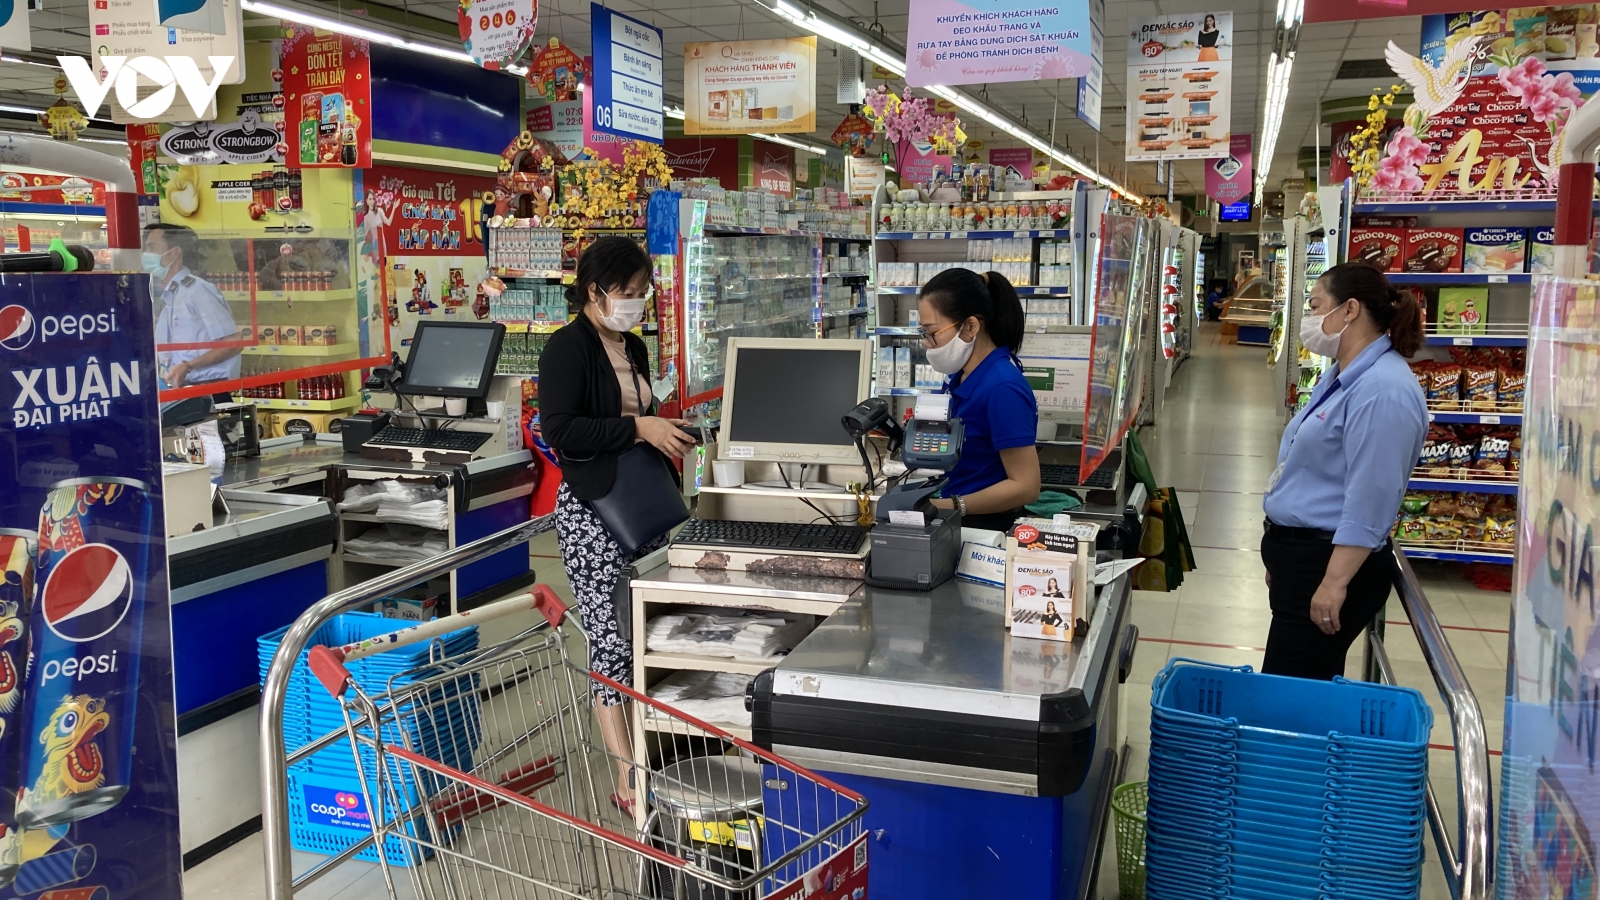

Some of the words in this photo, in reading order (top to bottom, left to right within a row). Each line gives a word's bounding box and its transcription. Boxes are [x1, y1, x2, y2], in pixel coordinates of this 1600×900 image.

[482, 18, 488, 29] 2
[494, 15, 500, 26] 4
[508, 13, 514, 23] 6
[936, 11, 972, 24] KHUYẾN
[972, 10, 1000, 22] KHÍCH
[1001, 9, 1032, 20] KHÁCH
[1033, 6, 1059, 17] HÀNG
[112, 21, 125, 29] Phiếu
[138, 21, 151, 29] hàng
[953, 25, 972, 35] ĐEO
[972, 22, 997, 34] KHẨU
[998, 23, 1029, 33] TRANG
[1028, 19, 1041, 30] VÀ
[1141, 24, 1161, 33] ĐEN
[193, 35, 215, 43] paywave
[624, 25, 633, 37] Bột
[633, 29, 642, 40] ngũ
[641, 29, 650, 42] cốc
[917, 38, 936, 50] RỬA
[937, 39, 952, 50] TAY
[954, 35, 978, 49] BẰNG
[979, 35, 1005, 47] DUNG
[1005, 35, 1027, 46] DỊCH
[1028, 31, 1047, 43] SÁT
[1047, 29, 1079, 43] KHUẨN
[114, 48, 123, 56] Quy
[935, 50, 948, 61] ĐỂ
[948, 49, 979, 61] PHÒNG
[981, 46, 1010, 60] TRÁNH
[1011, 47, 1033, 58] DỊCH
[1033, 43, 1059, 57] BỆNH
[1144, 45, 1163, 57] 80%
[308, 53, 326, 70] ĐÓN
[328, 50, 343, 68] TẾT
[623, 53, 634, 64] Bánh
[634, 57, 641, 66] ăn
[641, 59, 652, 72] sáng
[755, 55, 769, 63] RIÊNG
[704, 65, 729, 74] KHÁCH
[730, 63, 750, 73] HÀNG
[752, 61, 778, 72] THÀNH
[779, 60, 797, 70] VIÊN
[995, 65, 1013, 75] khách
[1013, 64, 1032, 74] hàng!
[306, 72, 328, 87] TRÀN
[330, 67, 346, 86] ĐẦY
[730, 75, 743, 83] Co.op
[742, 75, 756, 83] chung
[623, 81, 634, 93] Thức
[634, 86, 640, 95] ăn
[647, 88, 654, 98] bé
[565, 107, 584, 116] 07:0
[597, 104, 611, 128] 06
[618, 108, 628, 119] Sữa
[627, 112, 641, 123] nước,
[641, 114, 650, 124] sữa
[649, 115, 658, 127] đặc
[565, 117, 584, 126] 22:0
[1472, 115, 1515, 126] Choco-Pie
[221, 134, 276, 148] STRONGBOW
[246, 153, 266, 161] CIDERS
[664, 155, 709, 165] udweiser
[1420, 129, 1531, 195] An
[401, 184, 416, 199] Giỏ
[417, 187, 434, 202] quà
[435, 180, 457, 202] Tết
[760, 178, 772, 191] KING
[772, 179, 779, 191] OF
[401, 201, 430, 219] Chiết
[398, 219, 430, 250] HẤP
[431, 219, 461, 251] DẪN
[1469, 231, 1523, 242] Choco-Pie
[1459, 310, 1480, 324] Tok
[41, 307, 117, 343] pepsi
[11, 356, 141, 410] XUÂN
[1435, 372, 1459, 388] Swing
[1470, 370, 1496, 385] Swing
[1502, 377, 1526, 390] Swin
[13, 405, 52, 430] ĐẠI
[59, 397, 111, 423] PHÁT
[1420, 443, 1451, 458] MAXX
[1480, 439, 1510, 452] MAXX
[1018, 530, 1036, 543] 80%
[1044, 534, 1054, 543] Hãy
[1053, 534, 1061, 543] lấy
[1062, 542, 1076, 550] ngay!
[970, 550, 986, 563] Mời
[986, 553, 1006, 567] khác
[1020, 588, 1036, 597] 80%
[402, 610, 420, 620] NAN
[41, 649, 117, 687] pepsi
[310, 802, 347, 821] co.op
[346, 811, 371, 823] mart
[331, 818, 342, 827] bạn
[351, 822, 361, 830] mọi
[360, 822, 371, 830] nhà
